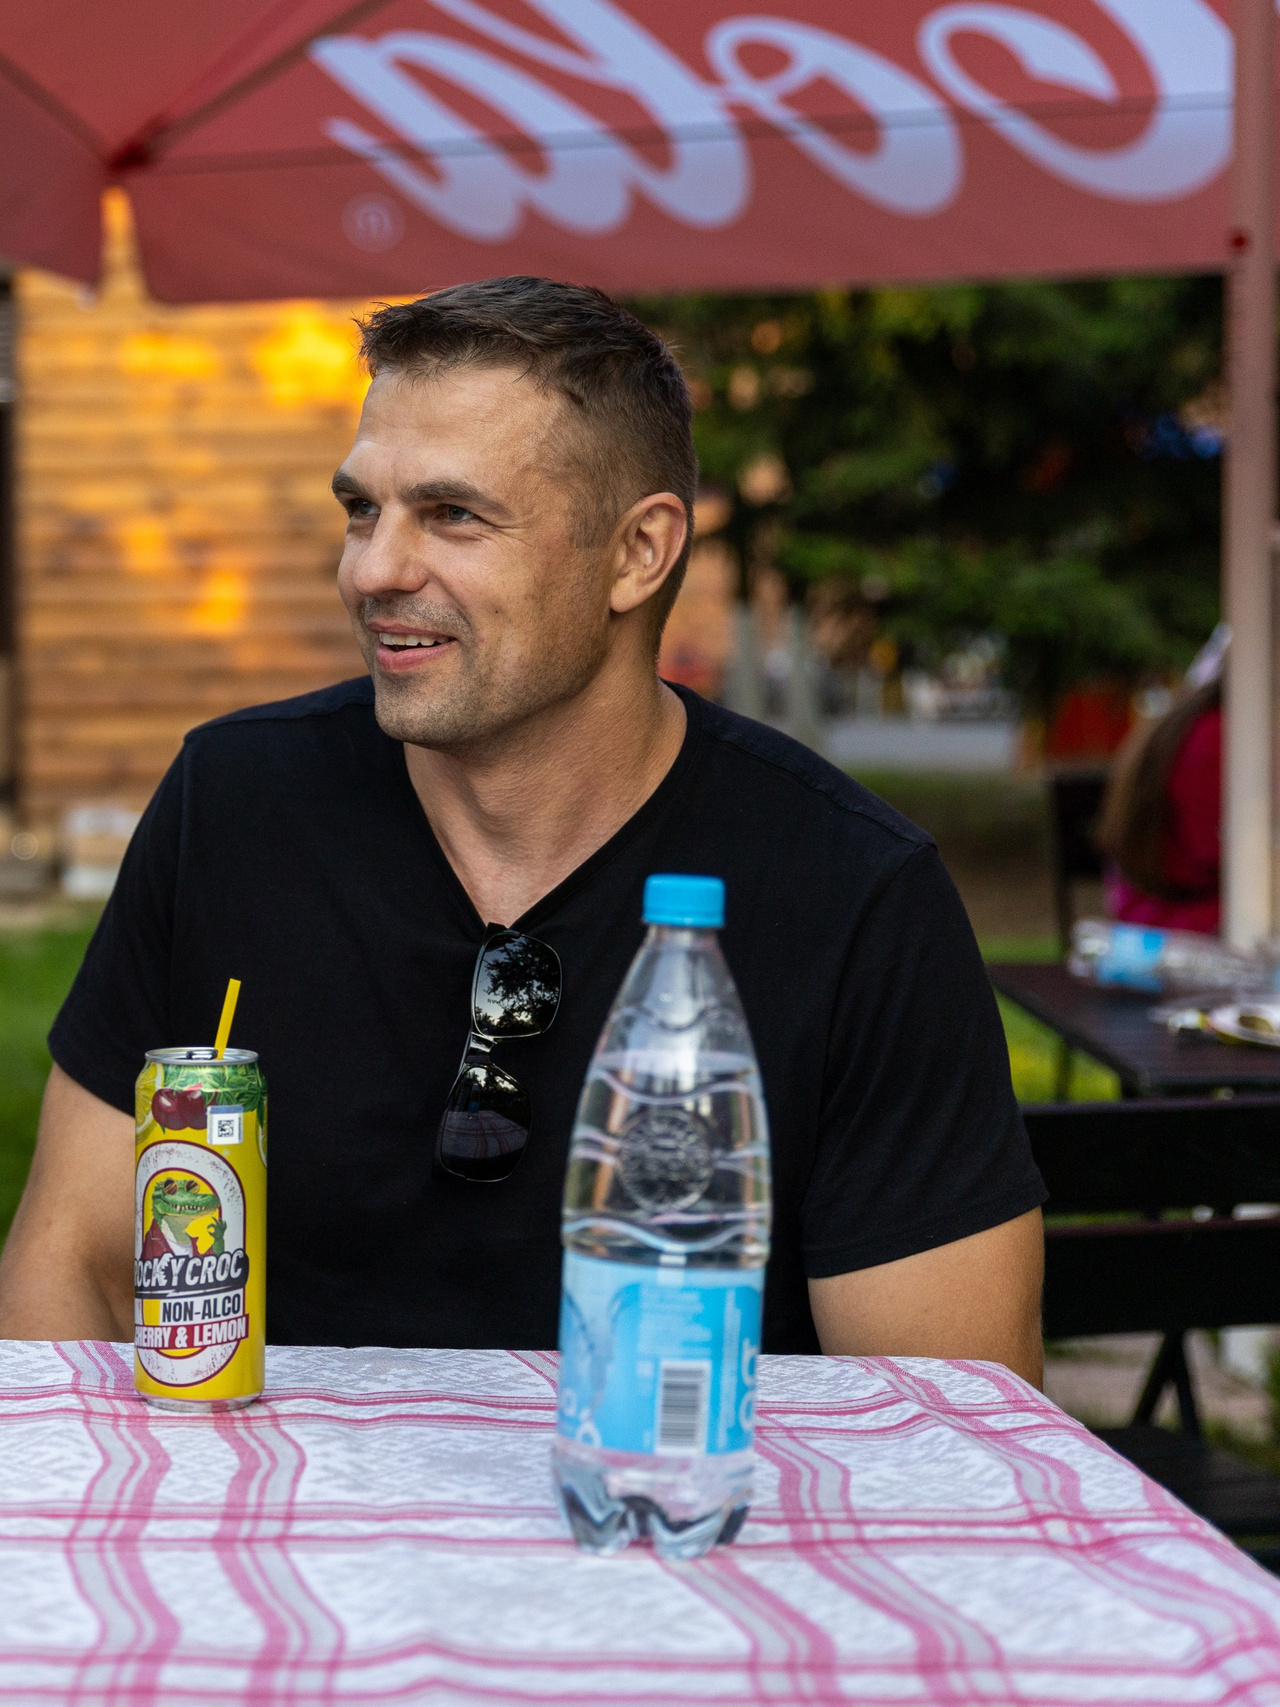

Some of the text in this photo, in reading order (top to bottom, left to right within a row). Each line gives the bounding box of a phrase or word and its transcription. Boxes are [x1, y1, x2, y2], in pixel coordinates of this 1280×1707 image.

[185, 1249, 244, 1286] CROC
[162, 1293, 242, 1323] NON-ALCO
[174, 1326, 188, 1348] &
[193, 1316, 246, 1347] LEMON
